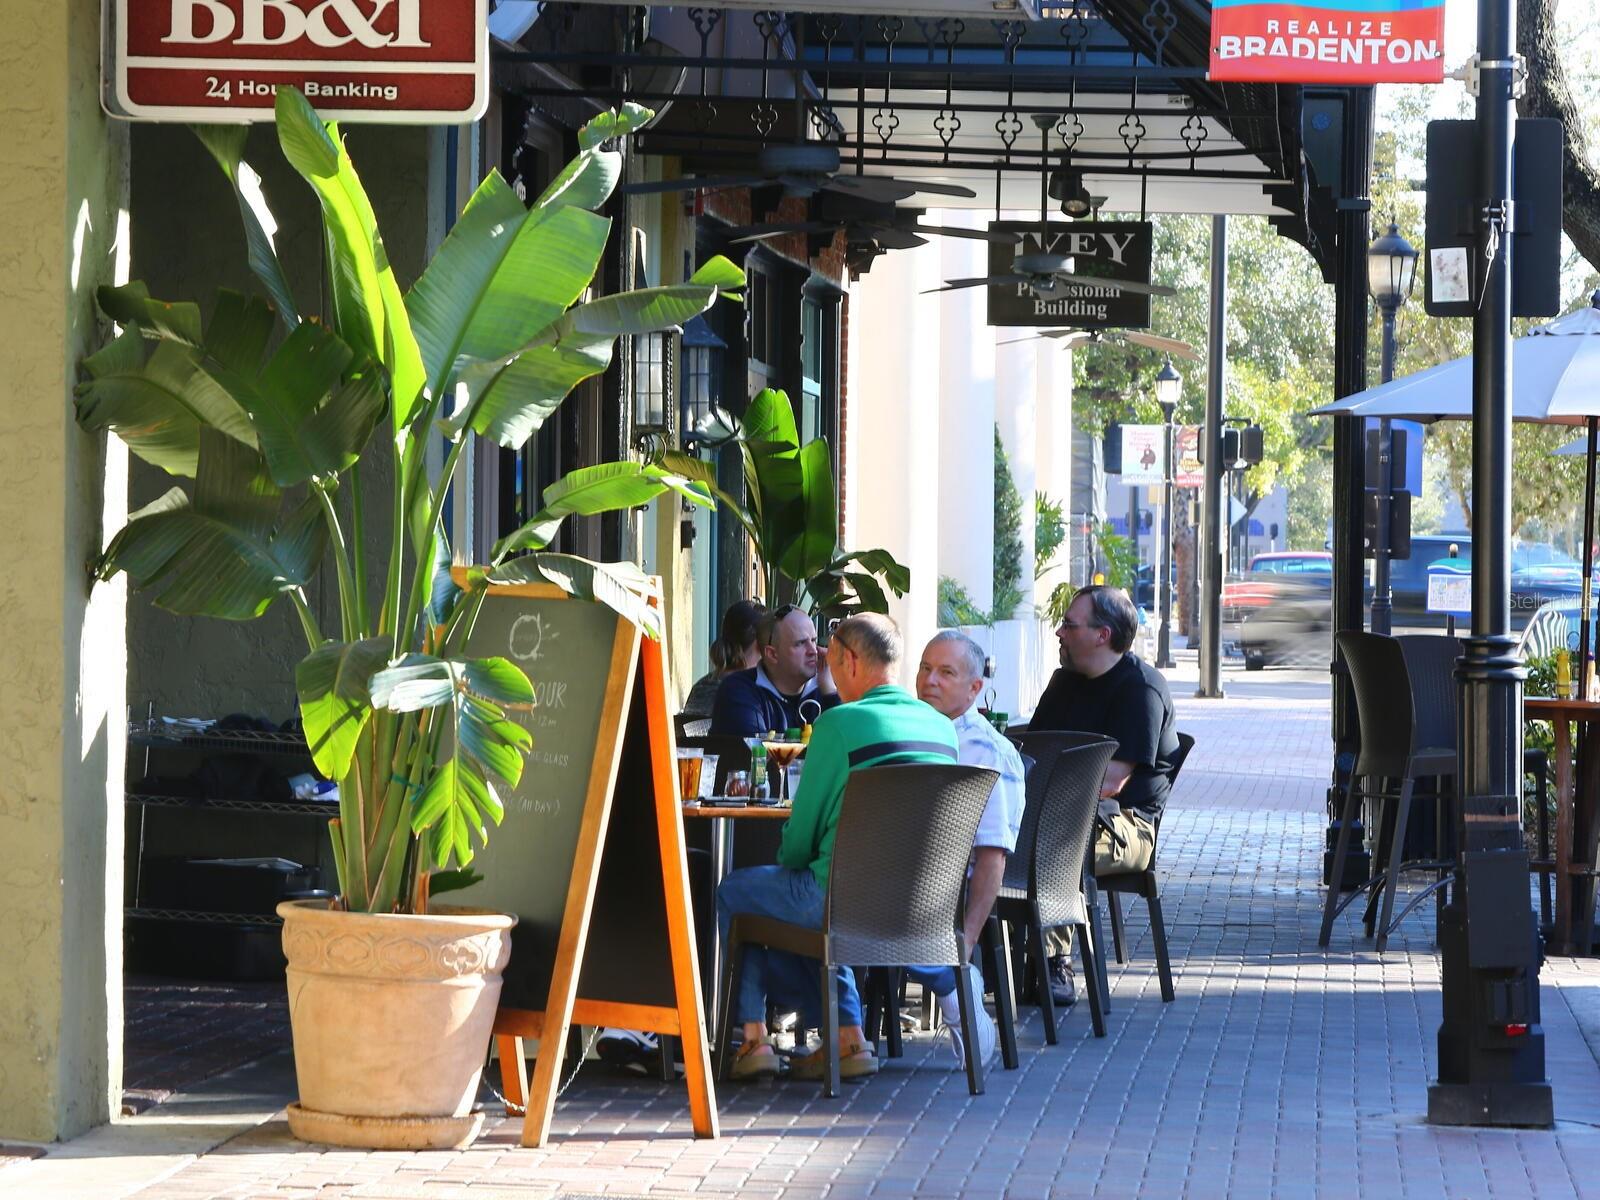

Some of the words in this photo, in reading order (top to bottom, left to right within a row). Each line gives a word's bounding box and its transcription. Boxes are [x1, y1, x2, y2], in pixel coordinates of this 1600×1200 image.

[1267, 19, 1392, 36] REALIZE
[1219, 35, 1437, 65] BRADENTON
[205, 76, 231, 101] 24
[238, 80, 292, 96] Hou
[304, 81, 398, 101] Banking
[1013, 231, 1136, 267] IVEY
[1016, 281, 1121, 299] Prsional
[1033, 299, 1108, 320] Building
[533, 681, 568, 709] OUR
[543, 751, 569, 768] GLASS
